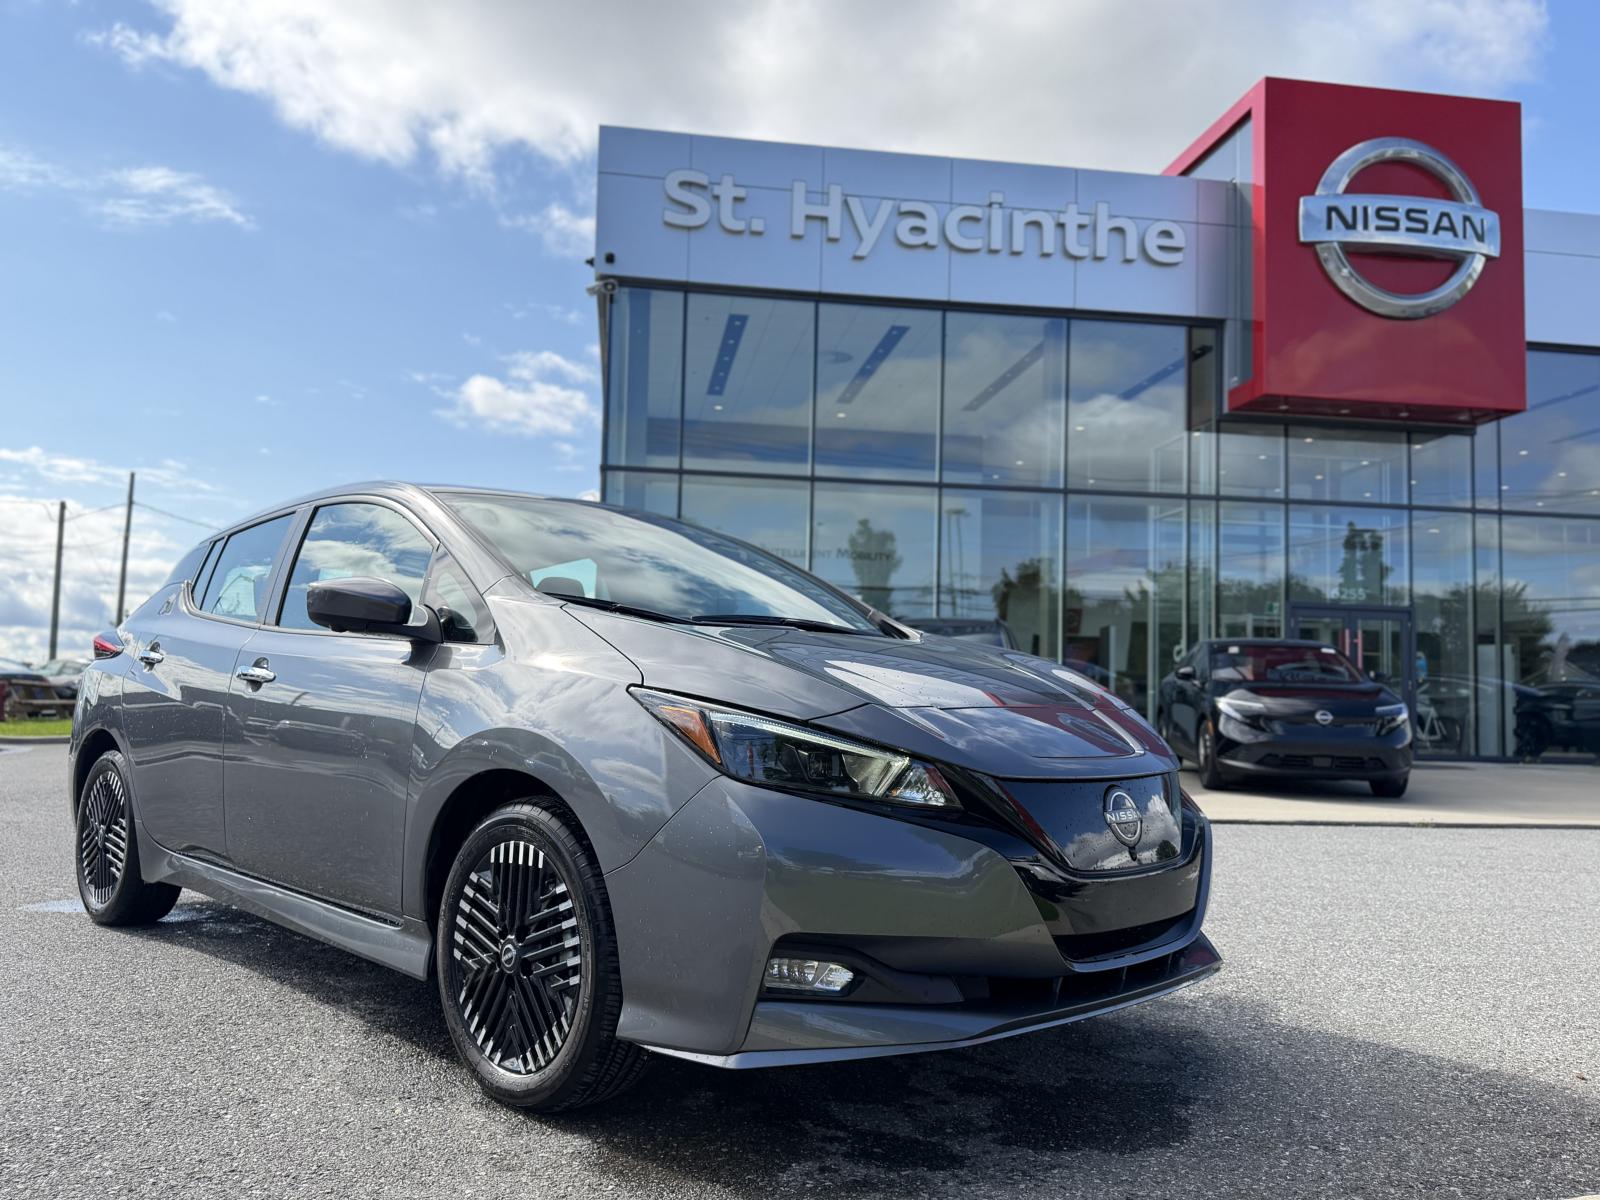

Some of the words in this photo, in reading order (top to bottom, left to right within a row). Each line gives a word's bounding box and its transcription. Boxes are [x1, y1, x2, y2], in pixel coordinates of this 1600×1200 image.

[662, 169, 764, 235] St.
[790, 180, 1187, 266] Hyacinthe
[1325, 205, 1487, 243] NISSAN
